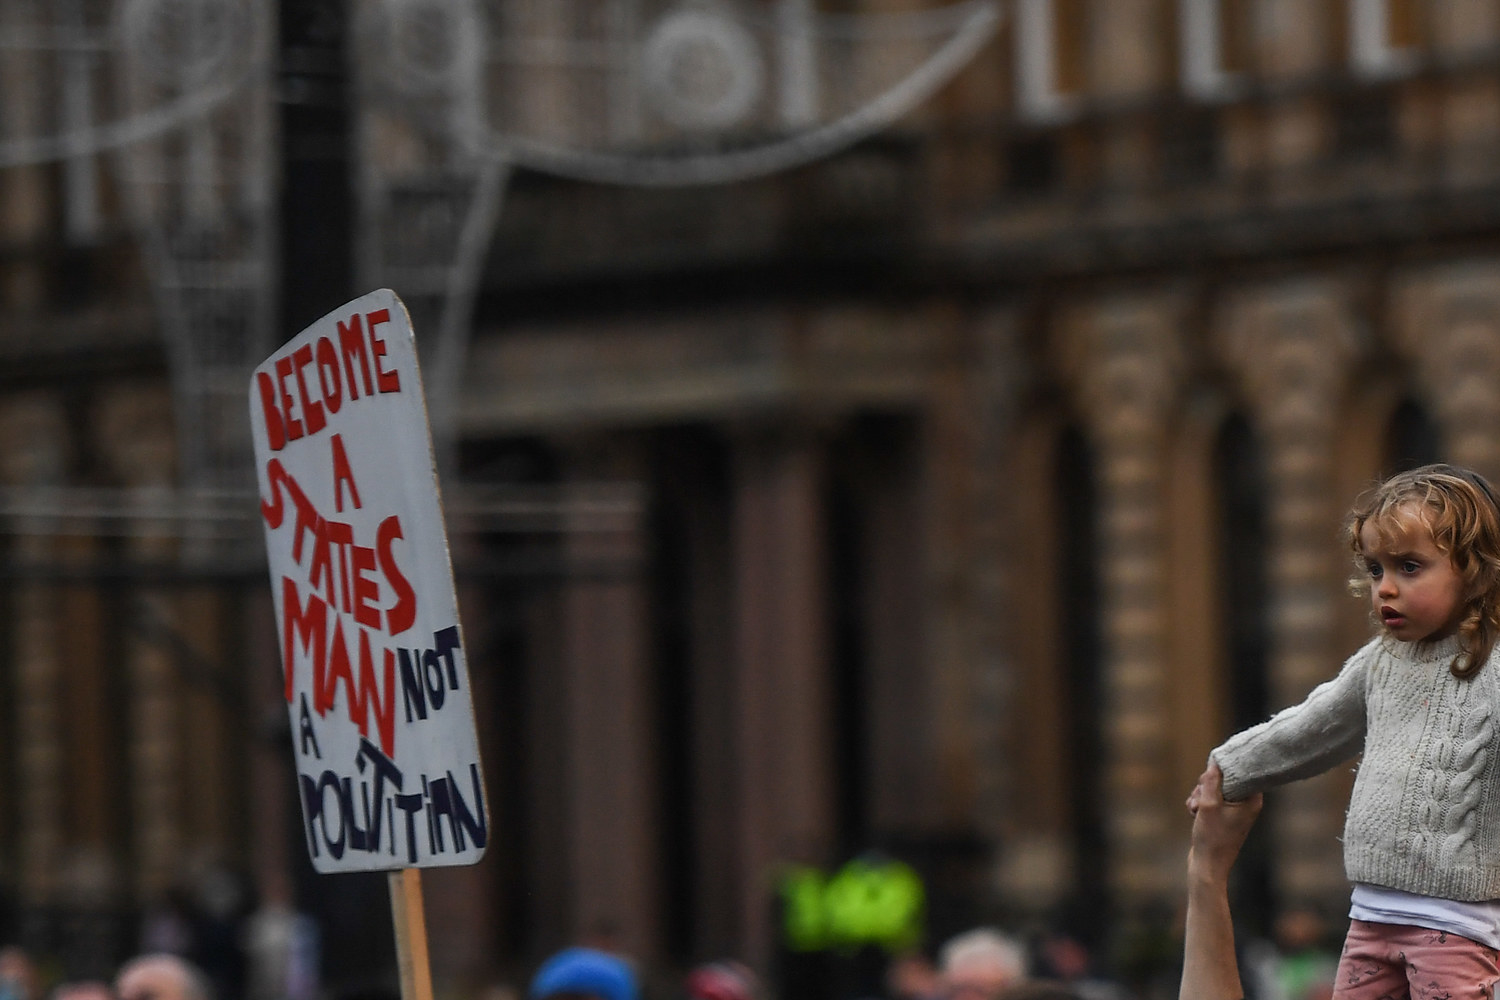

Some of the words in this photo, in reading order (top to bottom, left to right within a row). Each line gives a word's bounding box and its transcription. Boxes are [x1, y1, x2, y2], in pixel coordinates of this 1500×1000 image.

[257, 308, 400, 451] BECOME
[331, 433, 362, 513] A
[261, 458, 416, 637] STATES
[283, 576, 396, 760] MAN
[398, 625, 461, 723] NOT
[300, 691, 321, 759] A
